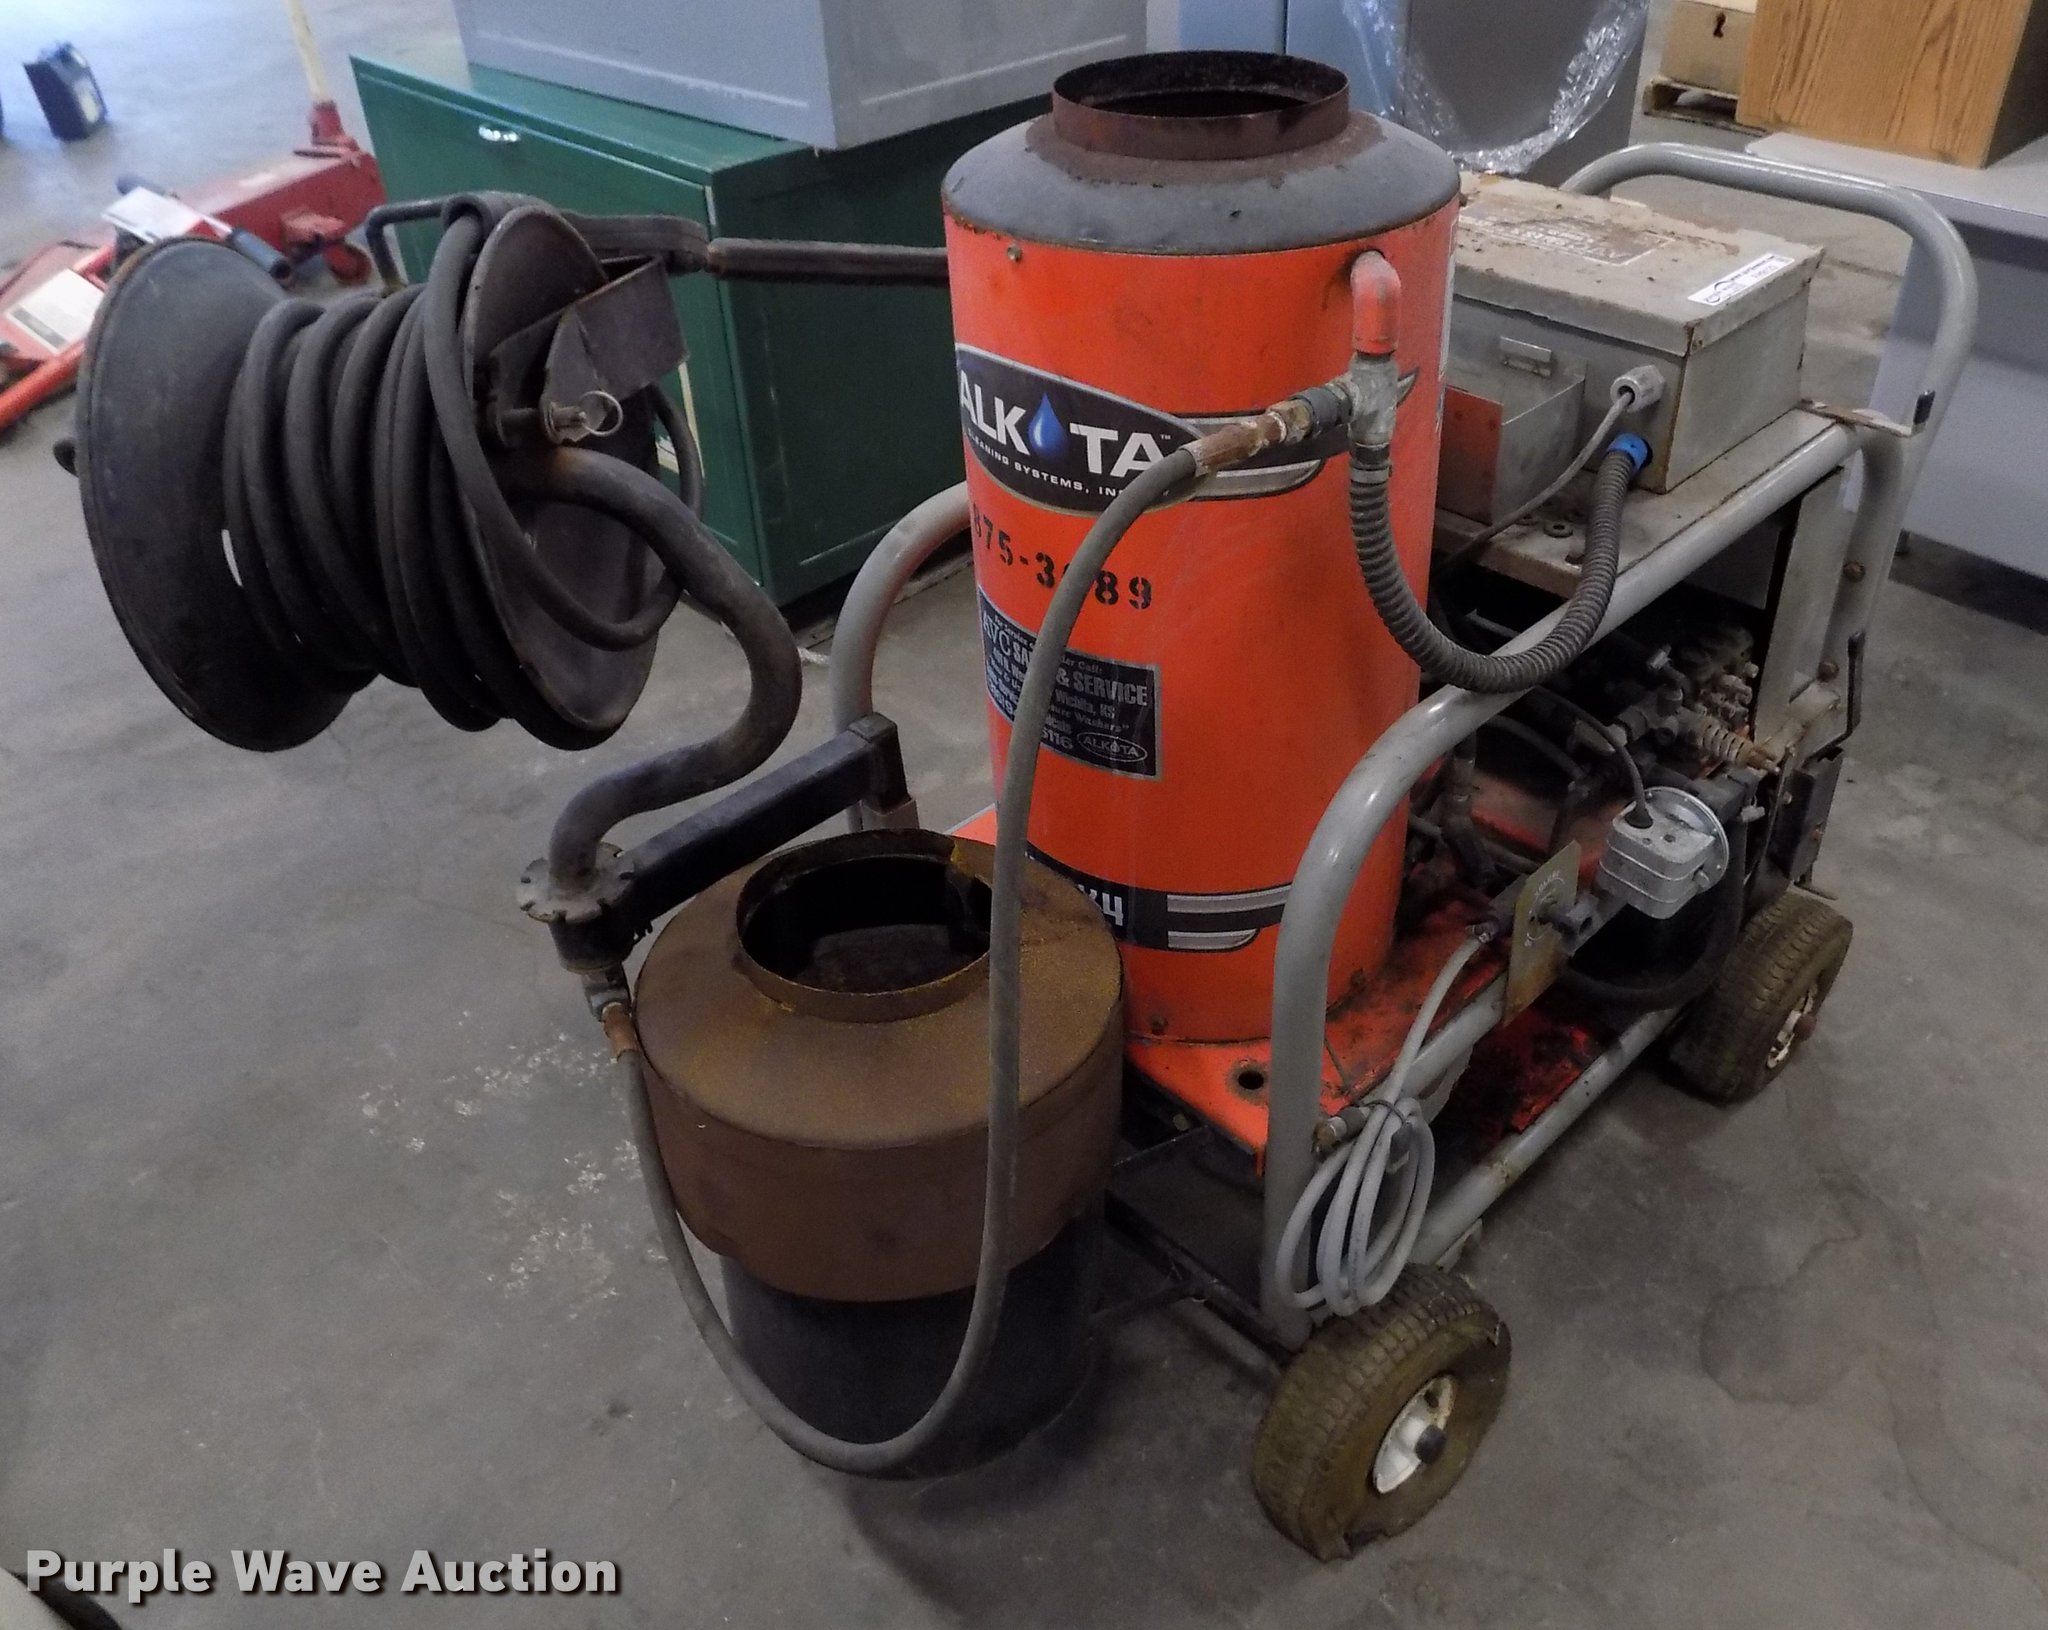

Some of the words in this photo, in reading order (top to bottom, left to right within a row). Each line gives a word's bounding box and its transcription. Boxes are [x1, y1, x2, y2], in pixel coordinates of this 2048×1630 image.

[1014, 461, 1089, 494] SYSTEMS,
[1099, 486, 1123, 497] IN
[973, 503, 1152, 610] 875-389
[1072, 671, 1148, 707] SERVICE
